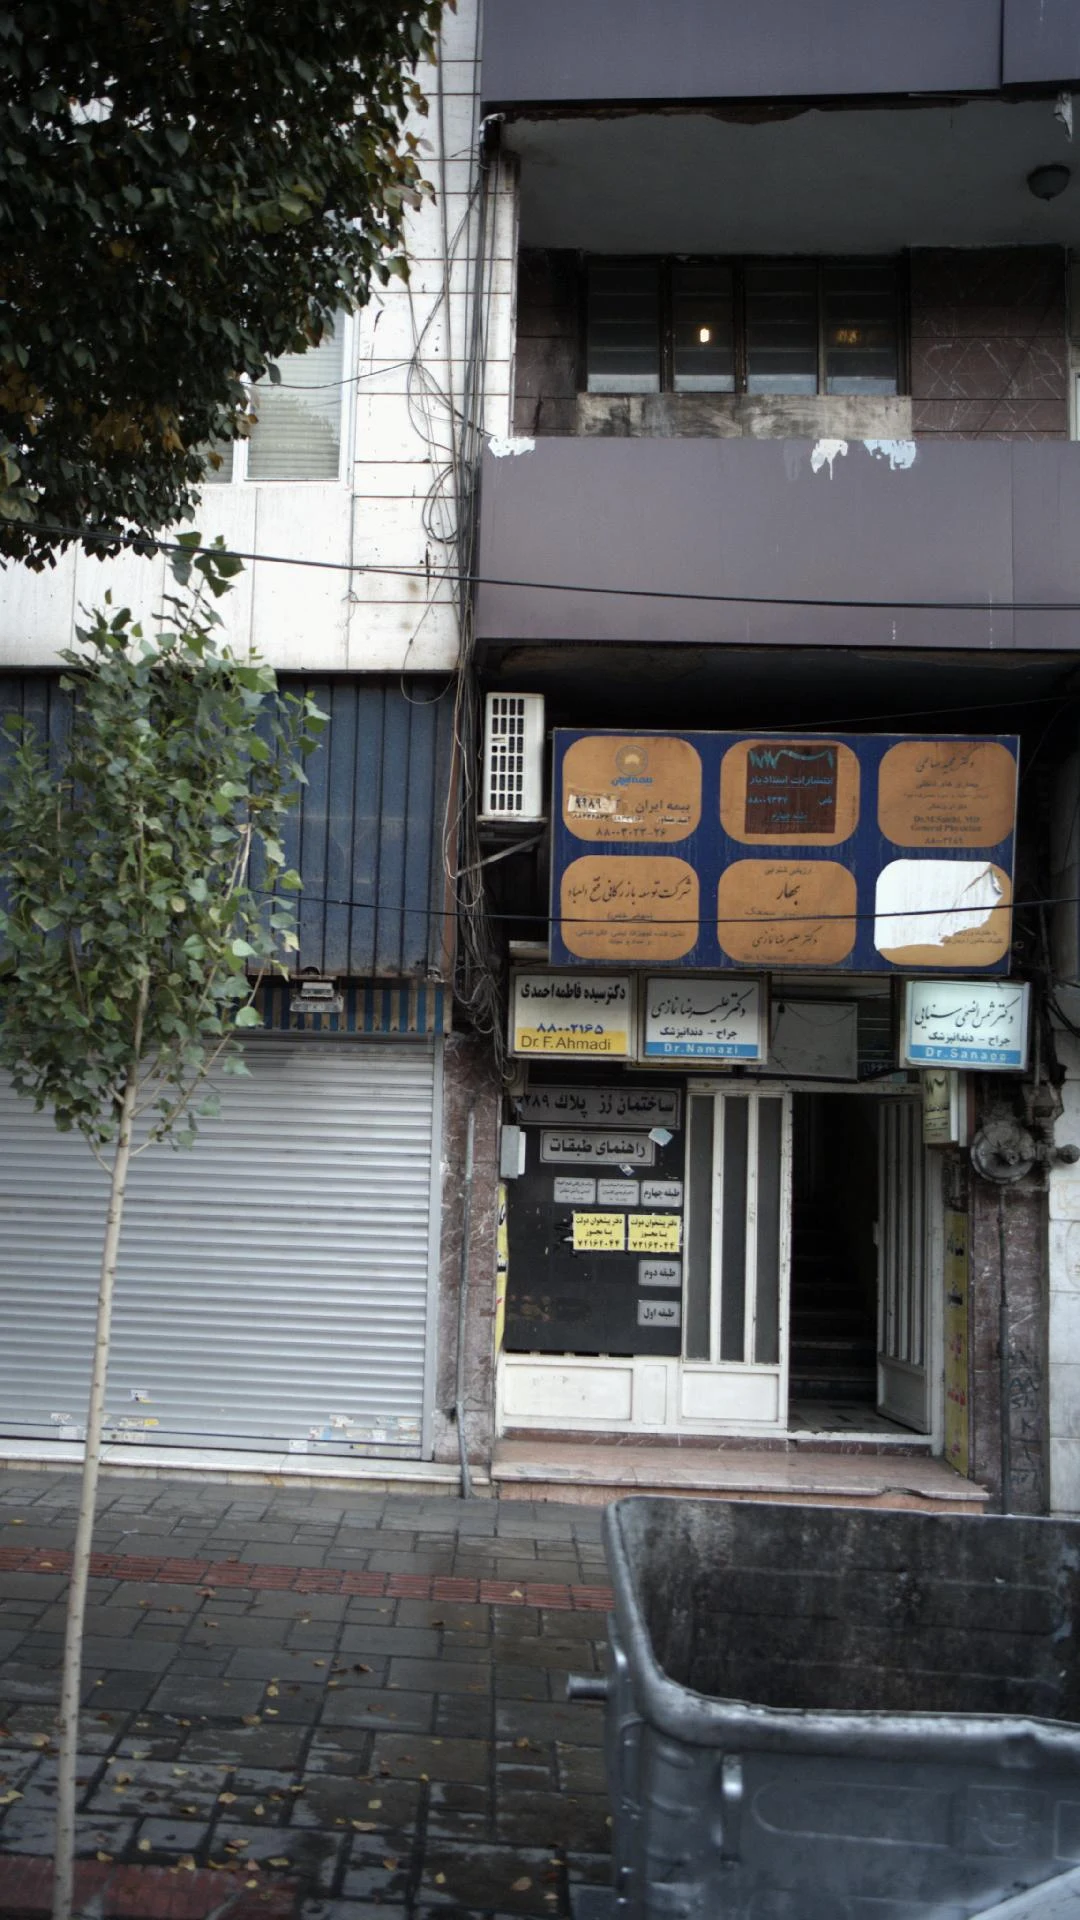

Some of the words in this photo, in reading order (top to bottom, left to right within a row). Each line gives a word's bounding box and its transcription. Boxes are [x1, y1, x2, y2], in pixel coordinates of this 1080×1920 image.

[635, 799, 664, 815] ایران
[667, 801, 690, 814] بیمه
[602, 880, 636, 905] بازرگانی
[638, 880, 660, 899] توسعه
[658, 875, 692, 901] شرکت
[776, 882, 800, 906] بهار
[521, 983, 555, 999] احمدی
[556, 982, 582, 999] فاطمه
[584, 989, 606, 1004] سیده
[605, 984, 626, 1005] دکتر
[651, 996, 679, 1019] نمازی
[680, 997, 730, 1023] علیرضا
[720, 987, 755, 1022] دکتر
[990, 996, 1021, 1028] دکتر
[660, 1027, 704, 1039] دندانپزشک
[716, 1028, 738, 1040] جراح
[928, 1032, 974, 1044] دندانپزشک
[521, 1035, 539, 1048] Dr.
[988, 1035, 1011, 1047] جراح
[616, 1095, 674, 1116] ساختمان
[550, 1138, 593, 1157] طبقات
[595, 1141, 646, 1158] راهنمای
[643, 1187, 662, 1200] چهارم
[663, 1187, 681, 1200] طبقه
[575, 1217, 590, 1226] دولت
[630, 1219, 645, 1228] دولت
[644, 1269, 658, 1280] دوم
[659, 1267, 676, 1280] طبقه
[643, 1307, 657, 1320] اول
[658, 1307, 675, 1321] طبقه
